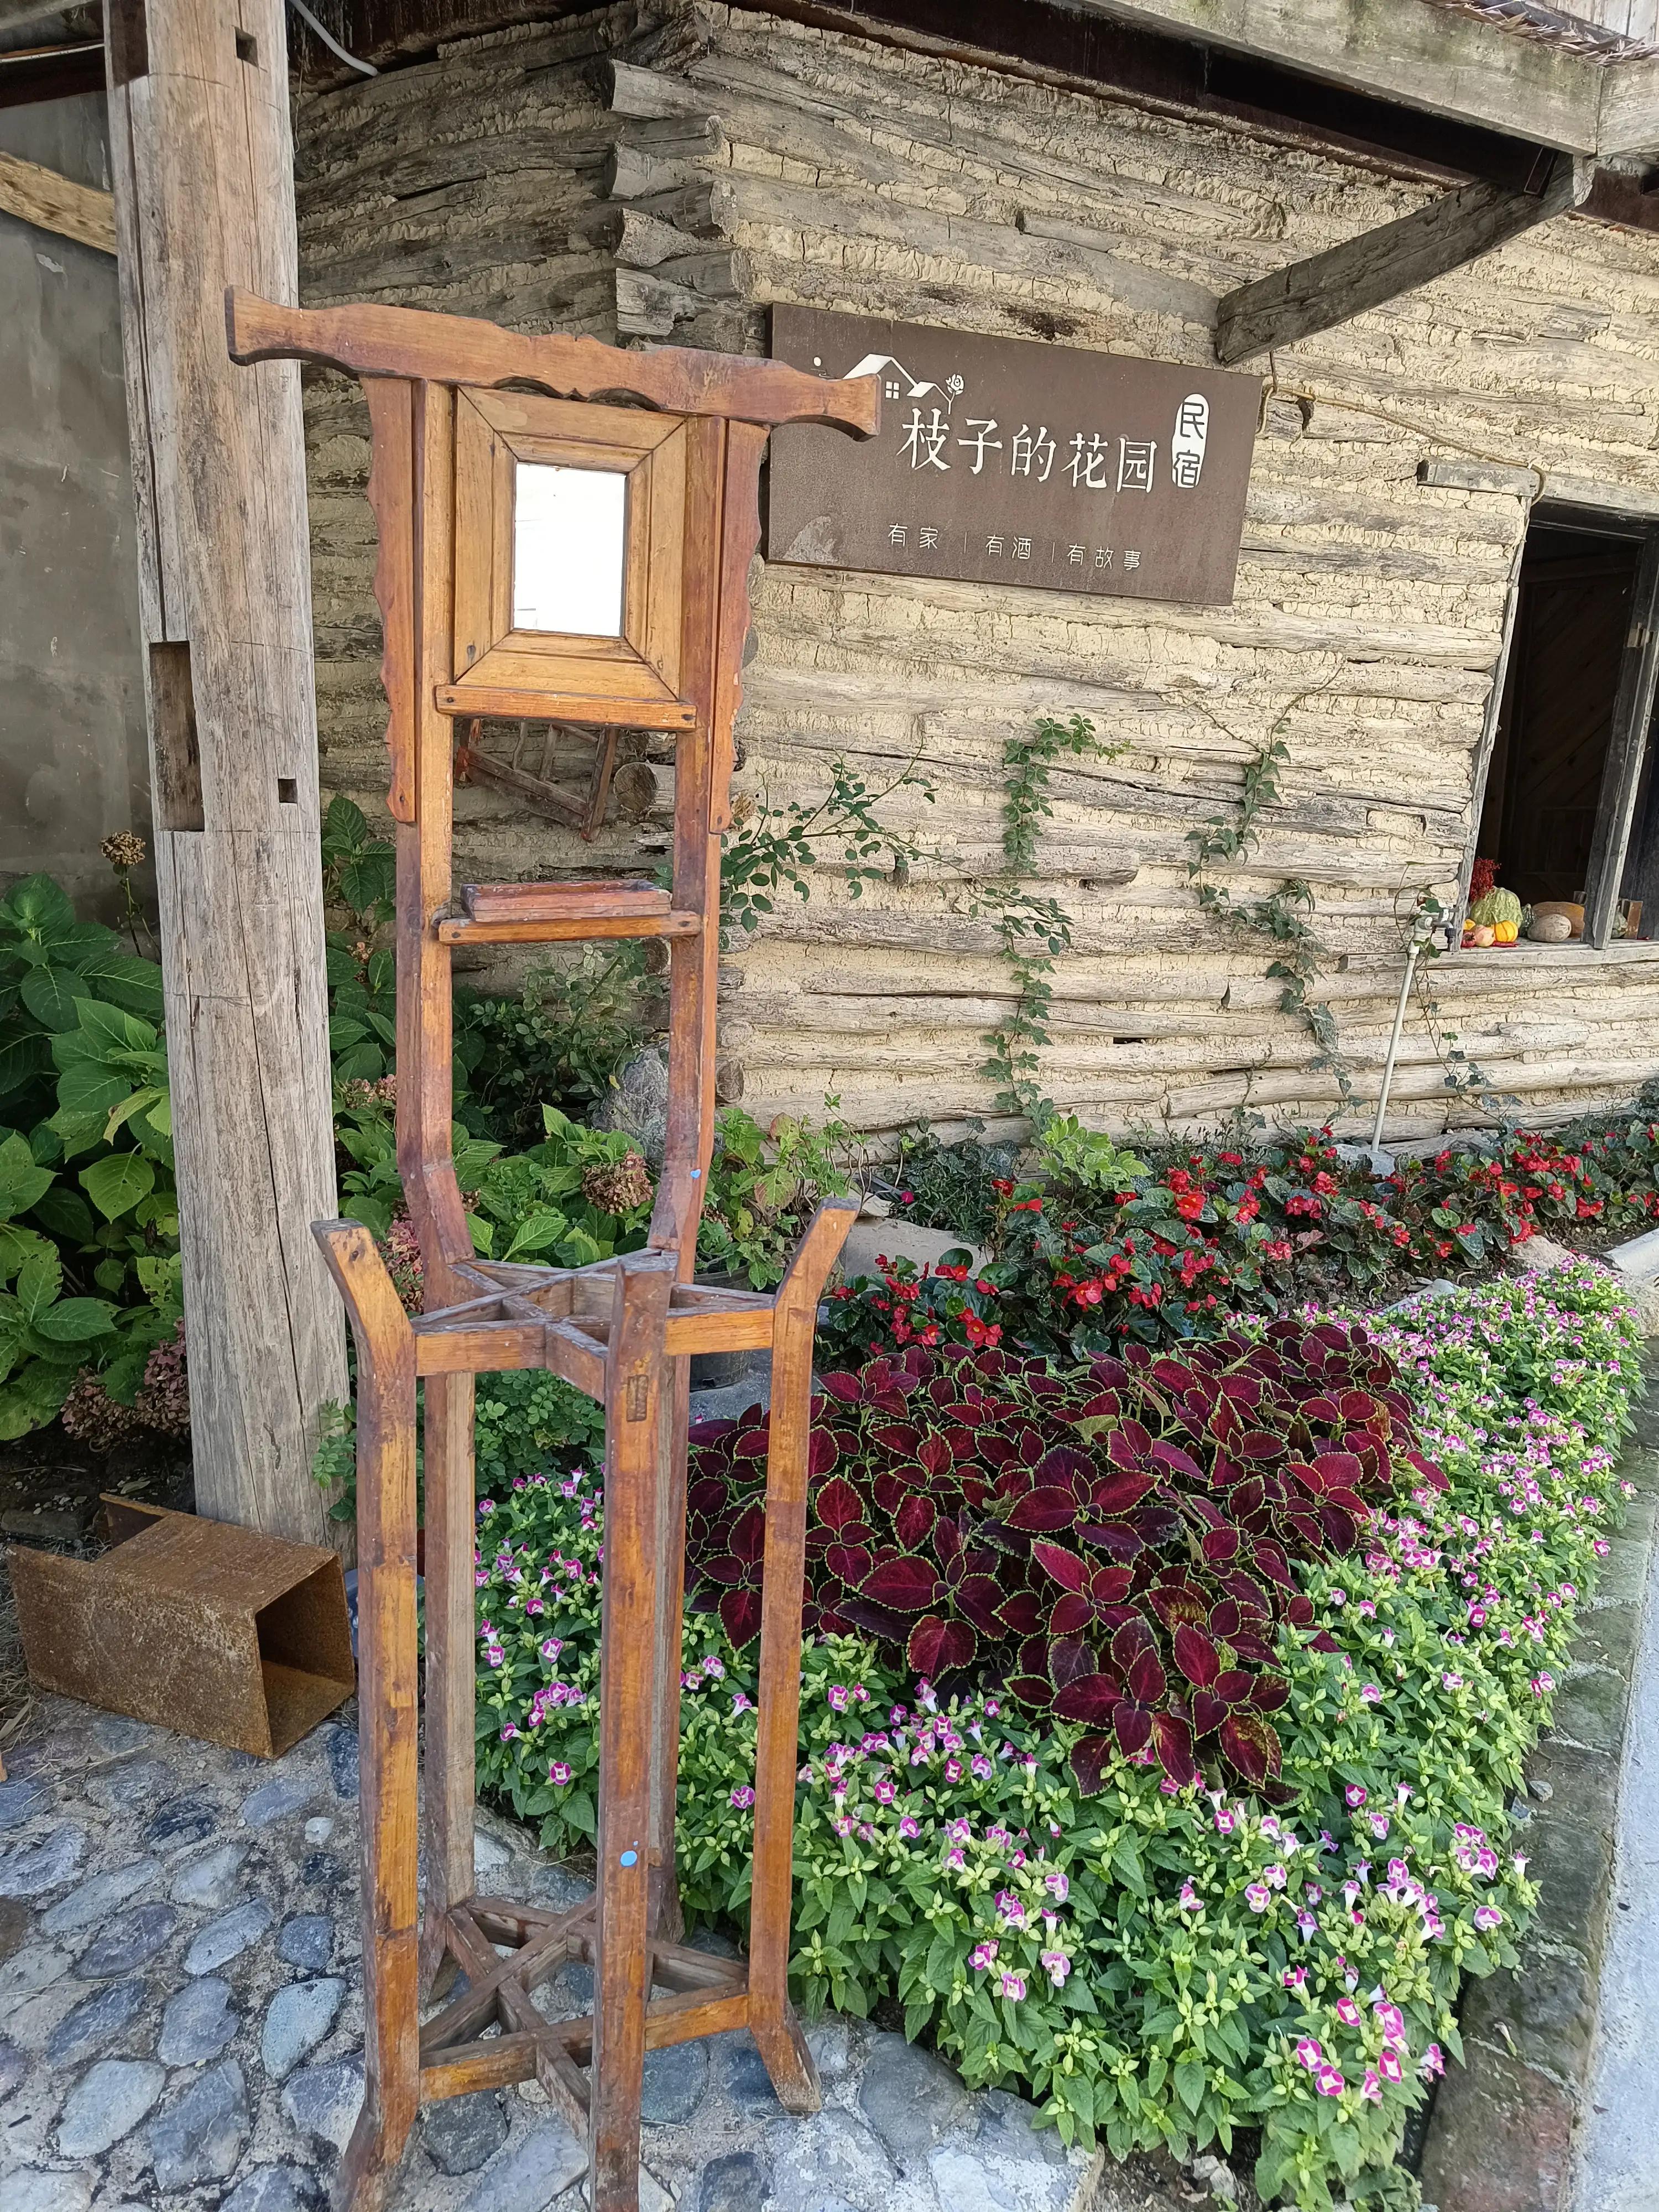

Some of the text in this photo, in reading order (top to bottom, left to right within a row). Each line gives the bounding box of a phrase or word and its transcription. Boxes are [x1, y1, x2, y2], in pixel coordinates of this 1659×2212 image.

[896, 408, 1157, 493] 枝子的花园
[1173, 401, 1204, 487] 民宿
[888, 523, 1141, 571] 有家 有酒 有故事
